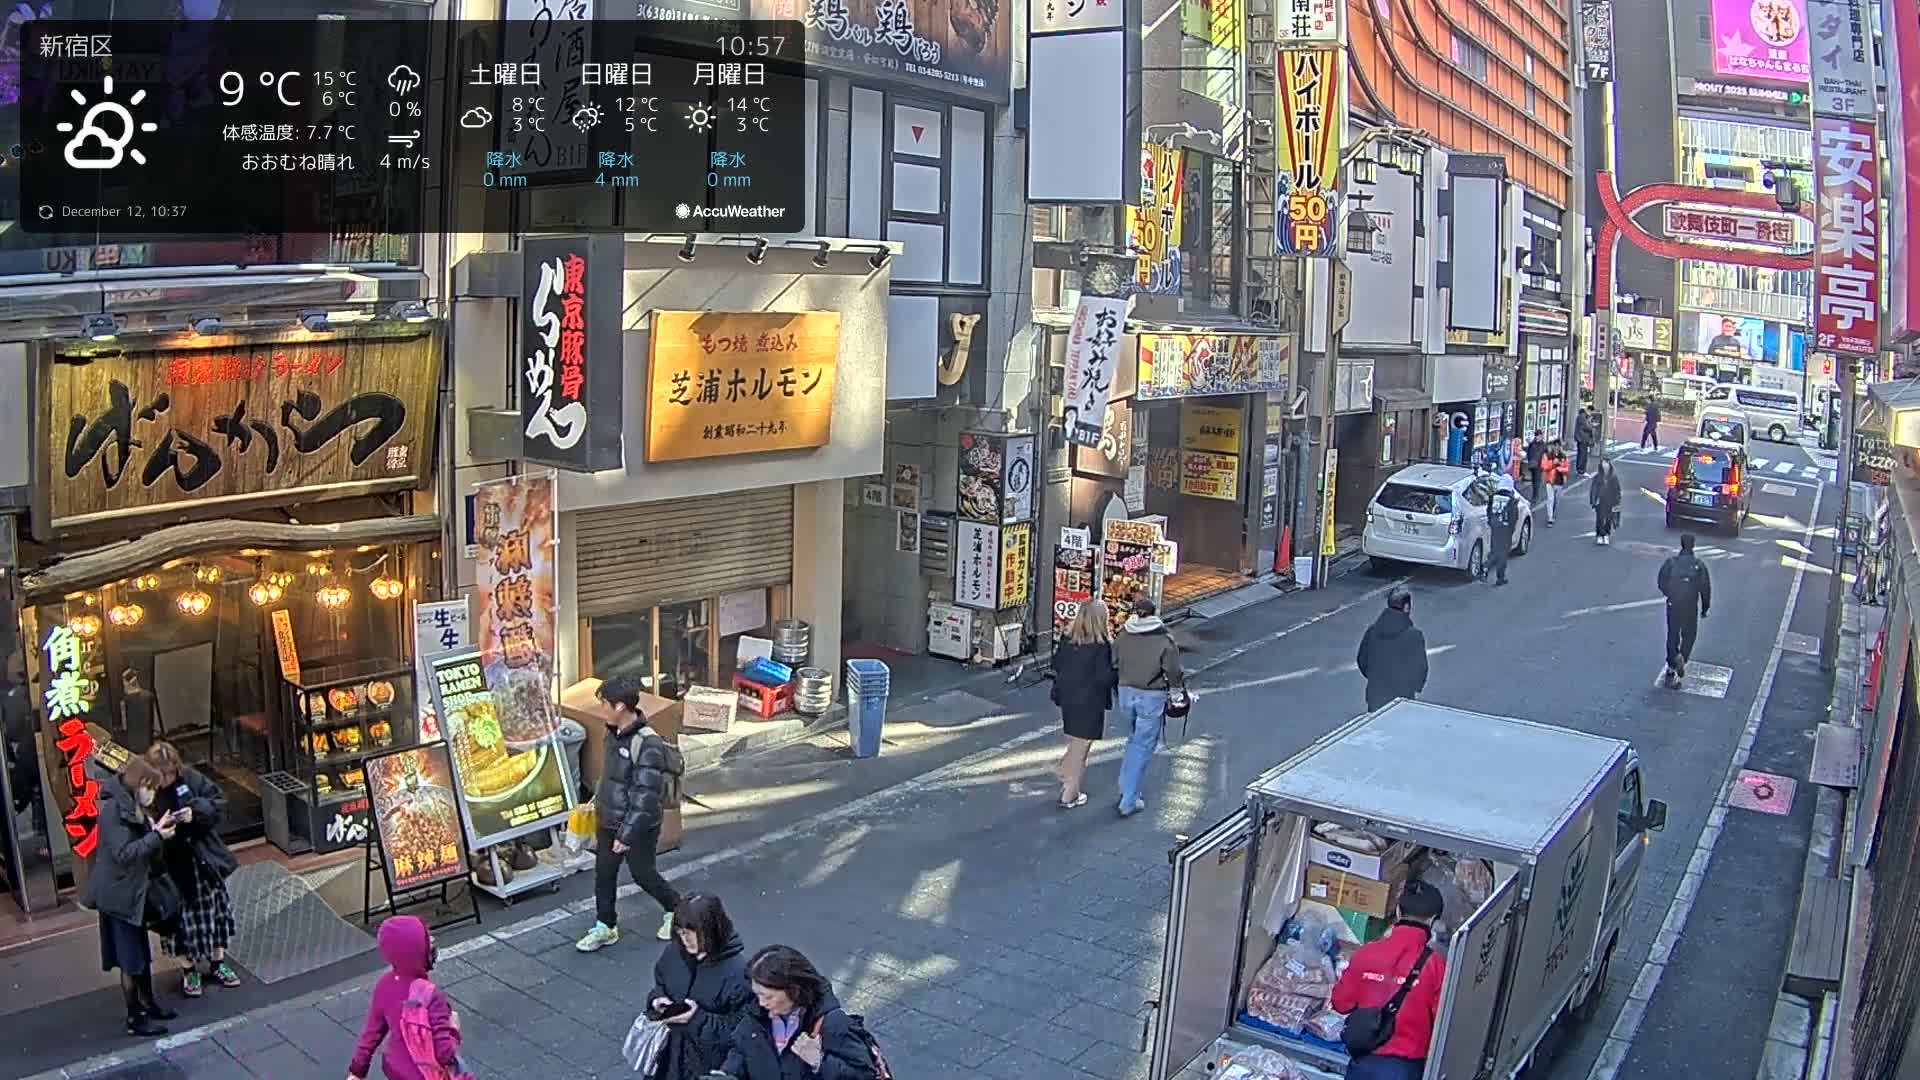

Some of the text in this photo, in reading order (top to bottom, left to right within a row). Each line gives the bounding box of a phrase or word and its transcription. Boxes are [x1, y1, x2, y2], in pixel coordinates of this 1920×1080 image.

[1588, 63, 1610, 78] 7F
[1295, 53, 1320, 190] ハイボール
[1832, 97, 1856, 111] 3F
[1160, 152, 1174, 289] ハイボール
[1670, 211, 1790, 242] 歌舞伎町一番街
[1819, 126, 1875, 329] 安楽亭
[560, 253, 586, 400] 東京豚骨
[702, 332, 800, 354] もつ焼 煮込み
[1818, 332, 1837, 347] 2F
[1081, 306, 1118, 412] お好み焼き
[669, 367, 823, 406] 芝浦ホルモン
[65, 379, 407, 494] ばんから
[971, 527, 983, 601] 芝浦ホルモン
[435, 662, 481, 683] TOKYO
[440, 675, 482, 696] RAMEN
[443, 691, 473, 709] SHOP
